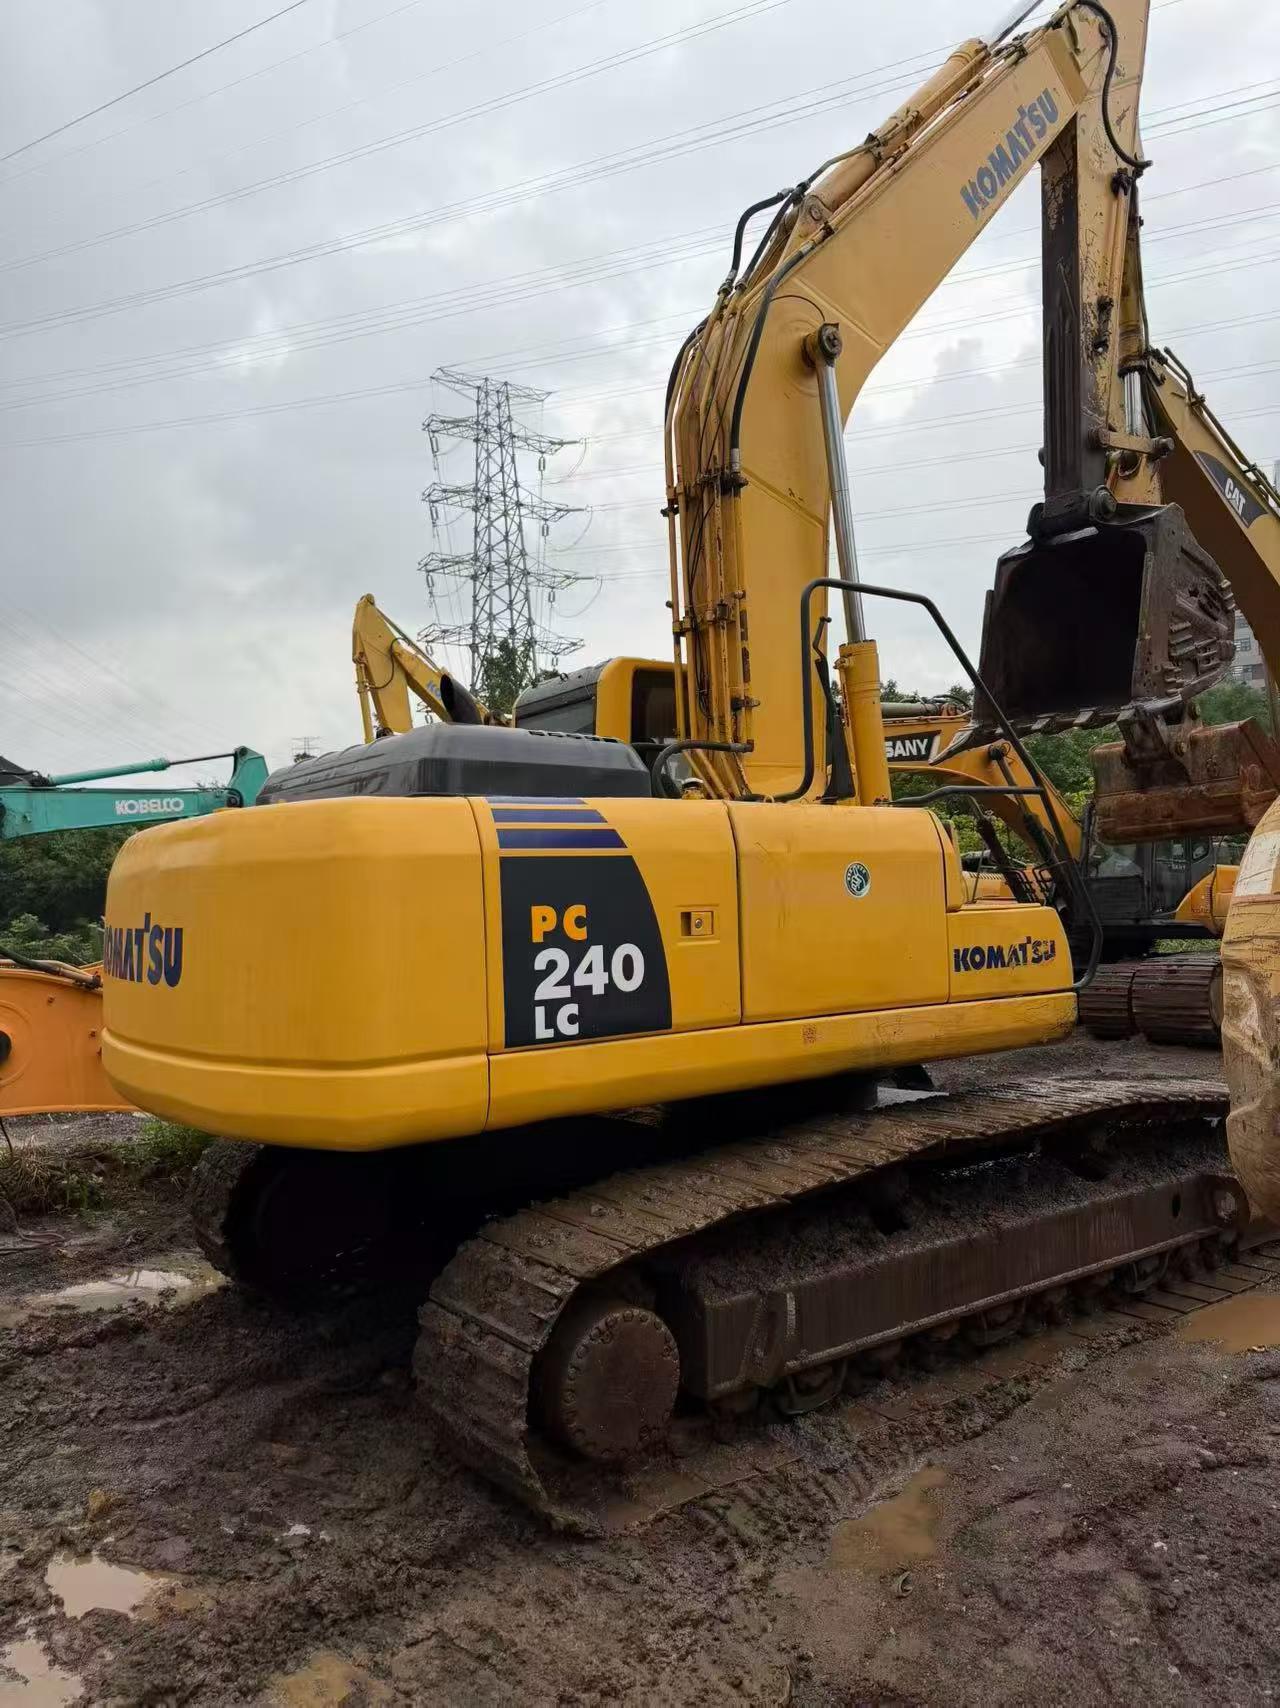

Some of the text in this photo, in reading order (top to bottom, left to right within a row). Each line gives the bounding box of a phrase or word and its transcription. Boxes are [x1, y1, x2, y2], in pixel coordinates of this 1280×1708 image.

[959, 87, 1059, 220] KOMATSU
[1225, 477, 1246, 516] CAT
[885, 738, 928, 758] SANY
[115, 797, 184, 816] KOBELCO
[530, 904, 588, 943] PC
[533, 943, 645, 1000] 240
[953, 935, 1056, 973] KOMATSU
[534, 1003, 579, 1040] LC
